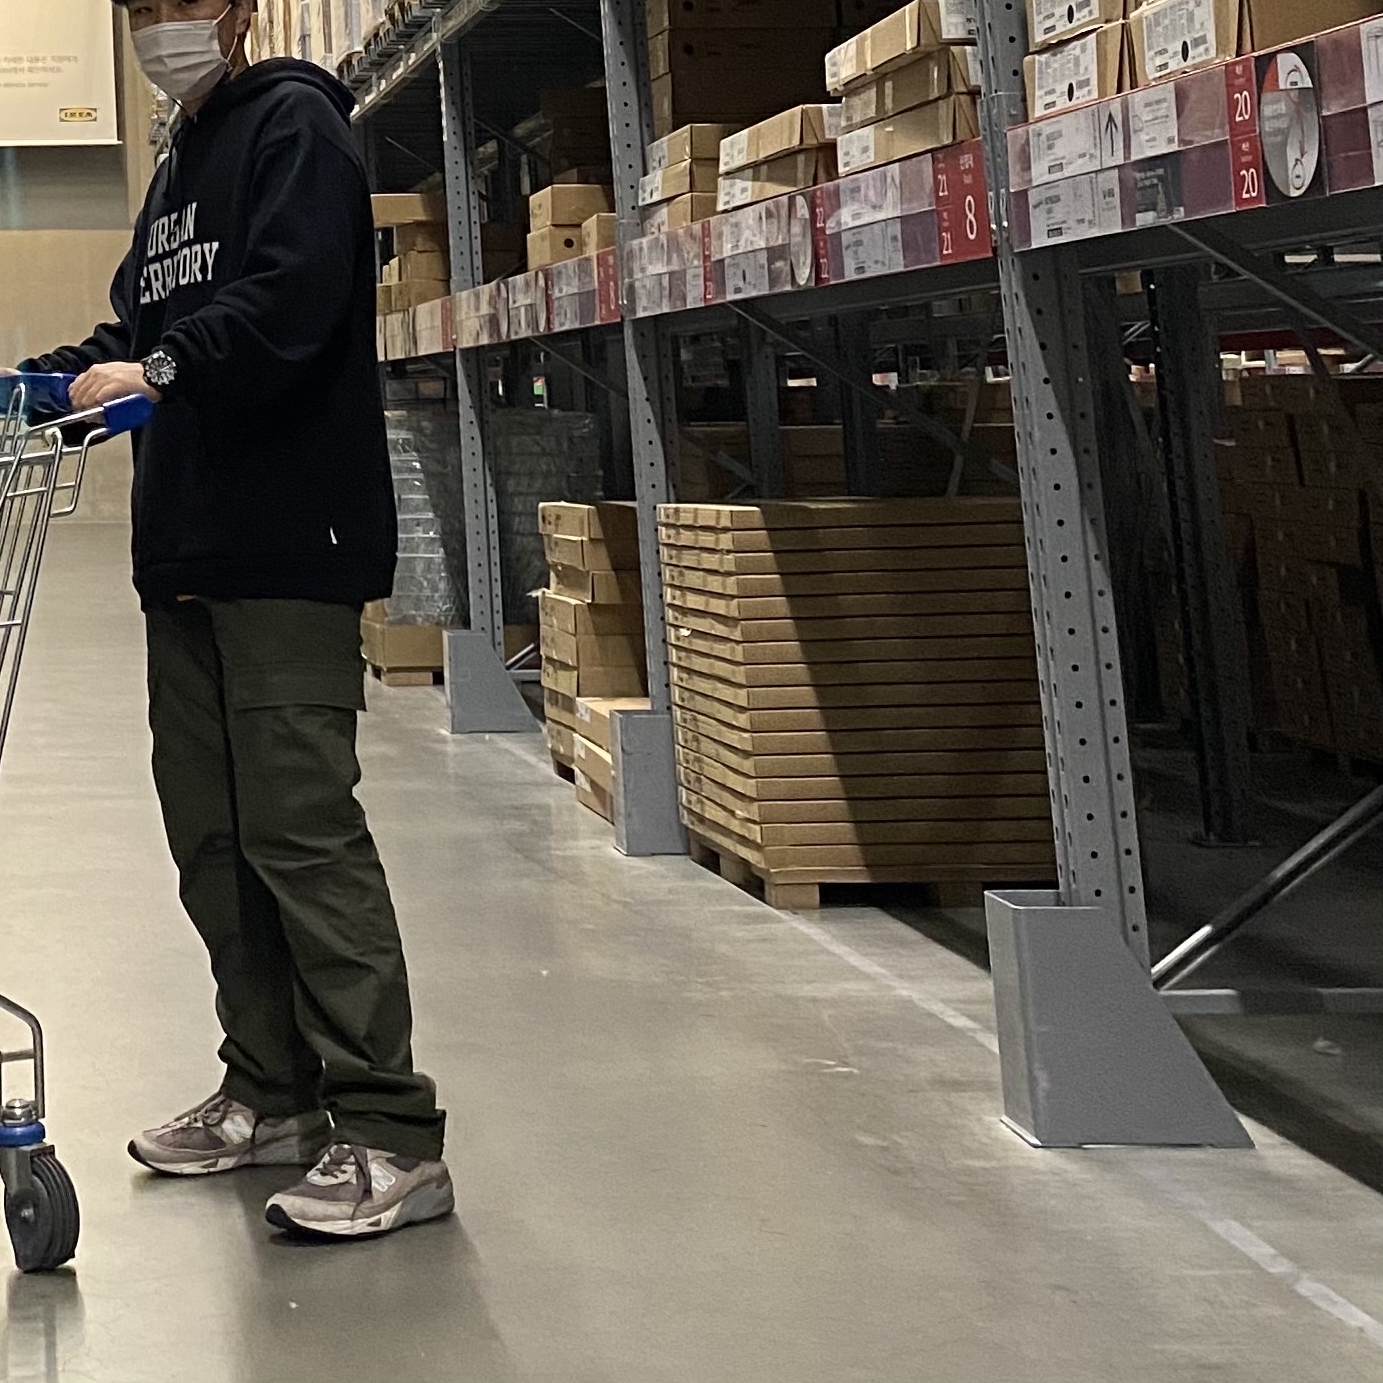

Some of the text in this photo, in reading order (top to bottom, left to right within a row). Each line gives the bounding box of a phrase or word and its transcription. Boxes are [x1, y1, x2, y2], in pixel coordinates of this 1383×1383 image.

[1233, 90, 1251, 122] 20
[937, 174, 949, 197] 21
[1239, 168, 1259, 200] 20
[964, 194, 978, 241] 8
[941, 231, 953, 255] 21
